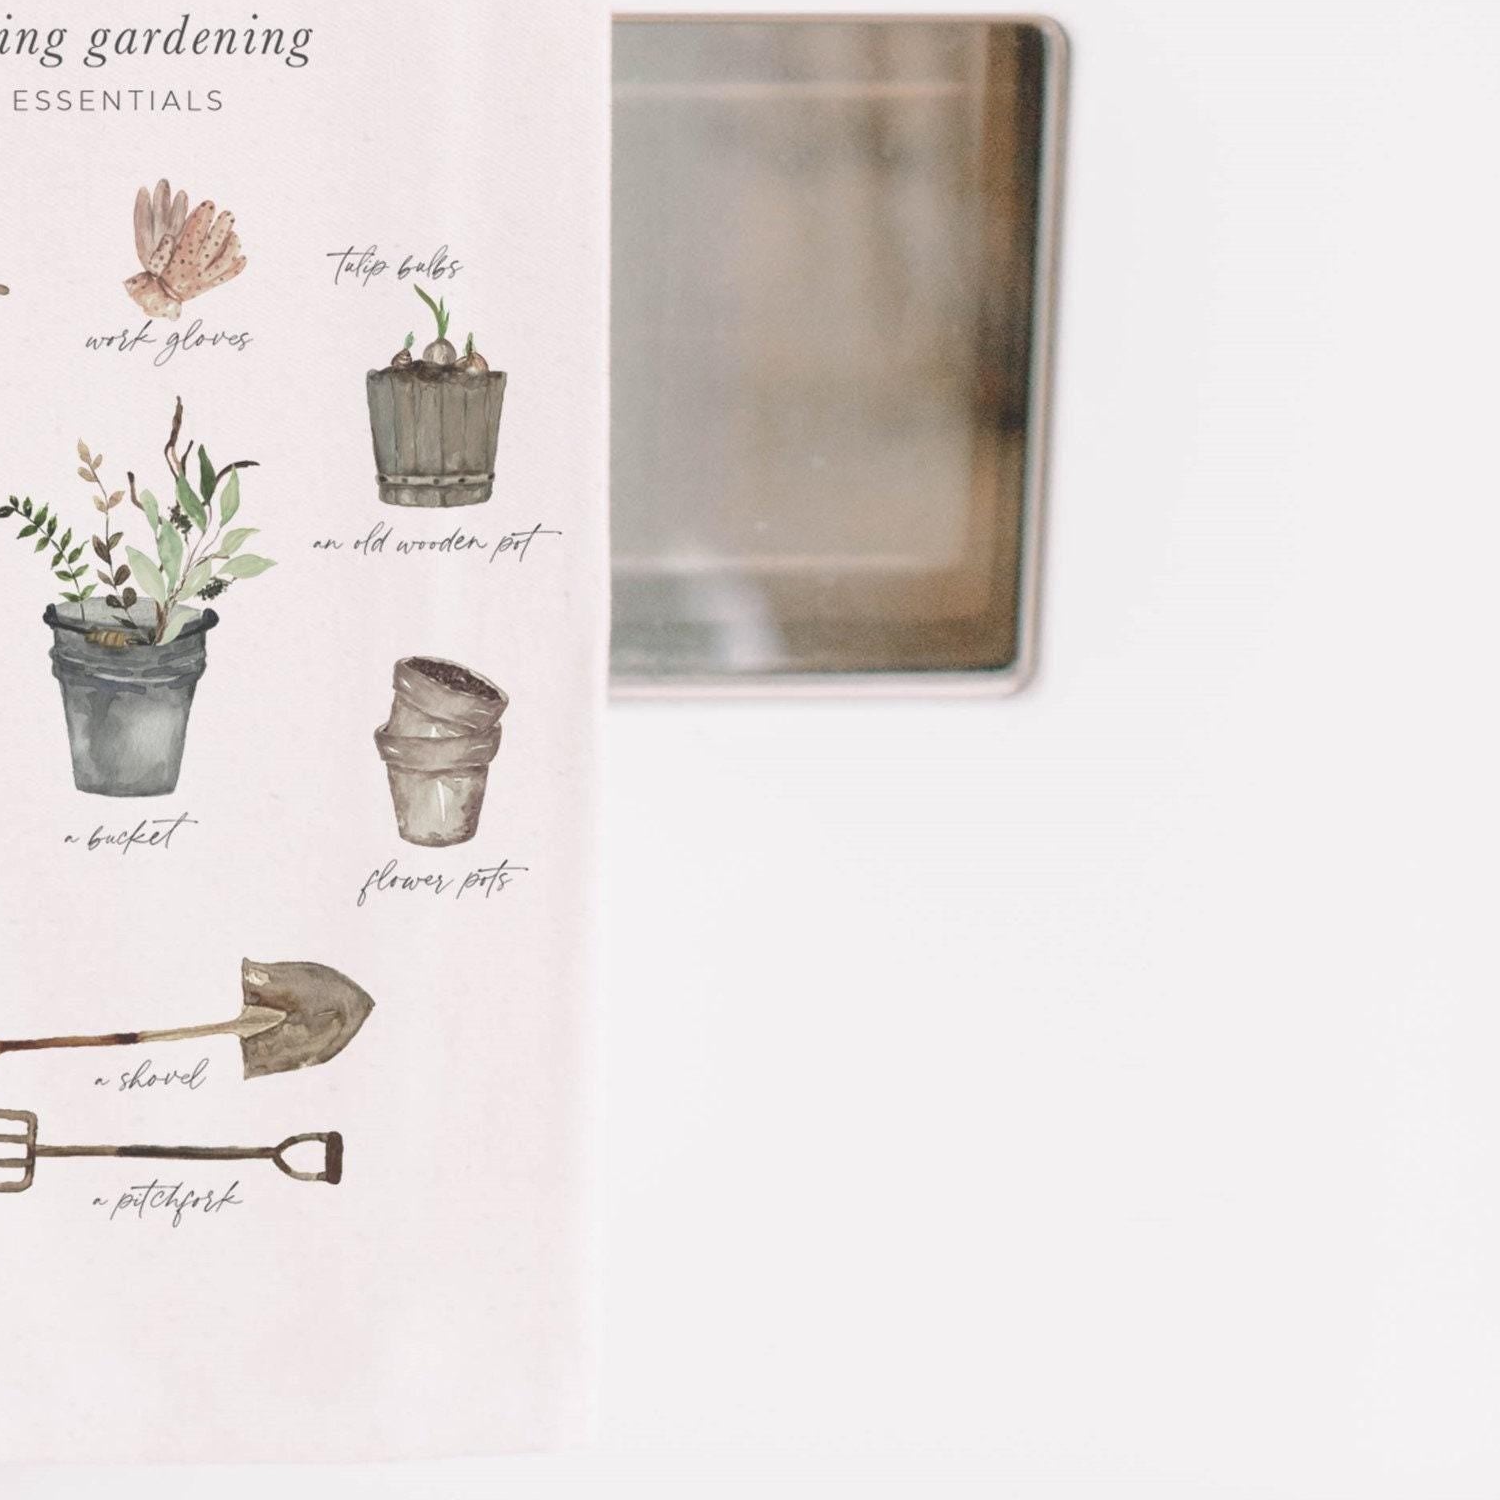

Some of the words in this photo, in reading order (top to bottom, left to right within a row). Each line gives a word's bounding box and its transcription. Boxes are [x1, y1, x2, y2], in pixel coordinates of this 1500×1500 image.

[82, 13, 314, 68] gardening
[13, 89, 223, 112] ESSENTIALS
[327, 246, 389, 287] tulip
[396, 245, 464, 281] bulbs
[85, 319, 157, 352] work
[154, 318, 252, 367] gloves
[312, 538, 344, 550] an
[353, 520, 394, 556] old
[396, 527, 488, 555] wooden
[490, 522, 563, 564] pot
[63, 834, 80, 844] a
[86, 811, 199, 855] bucket
[356, 858, 454, 908] flower
[455, 858, 530, 900] pots
[94, 1077, 110, 1086] a
[118, 1057, 210, 1092] shovel
[92, 1197, 109, 1206] a
[109, 1178, 243, 1229] pitchfork
